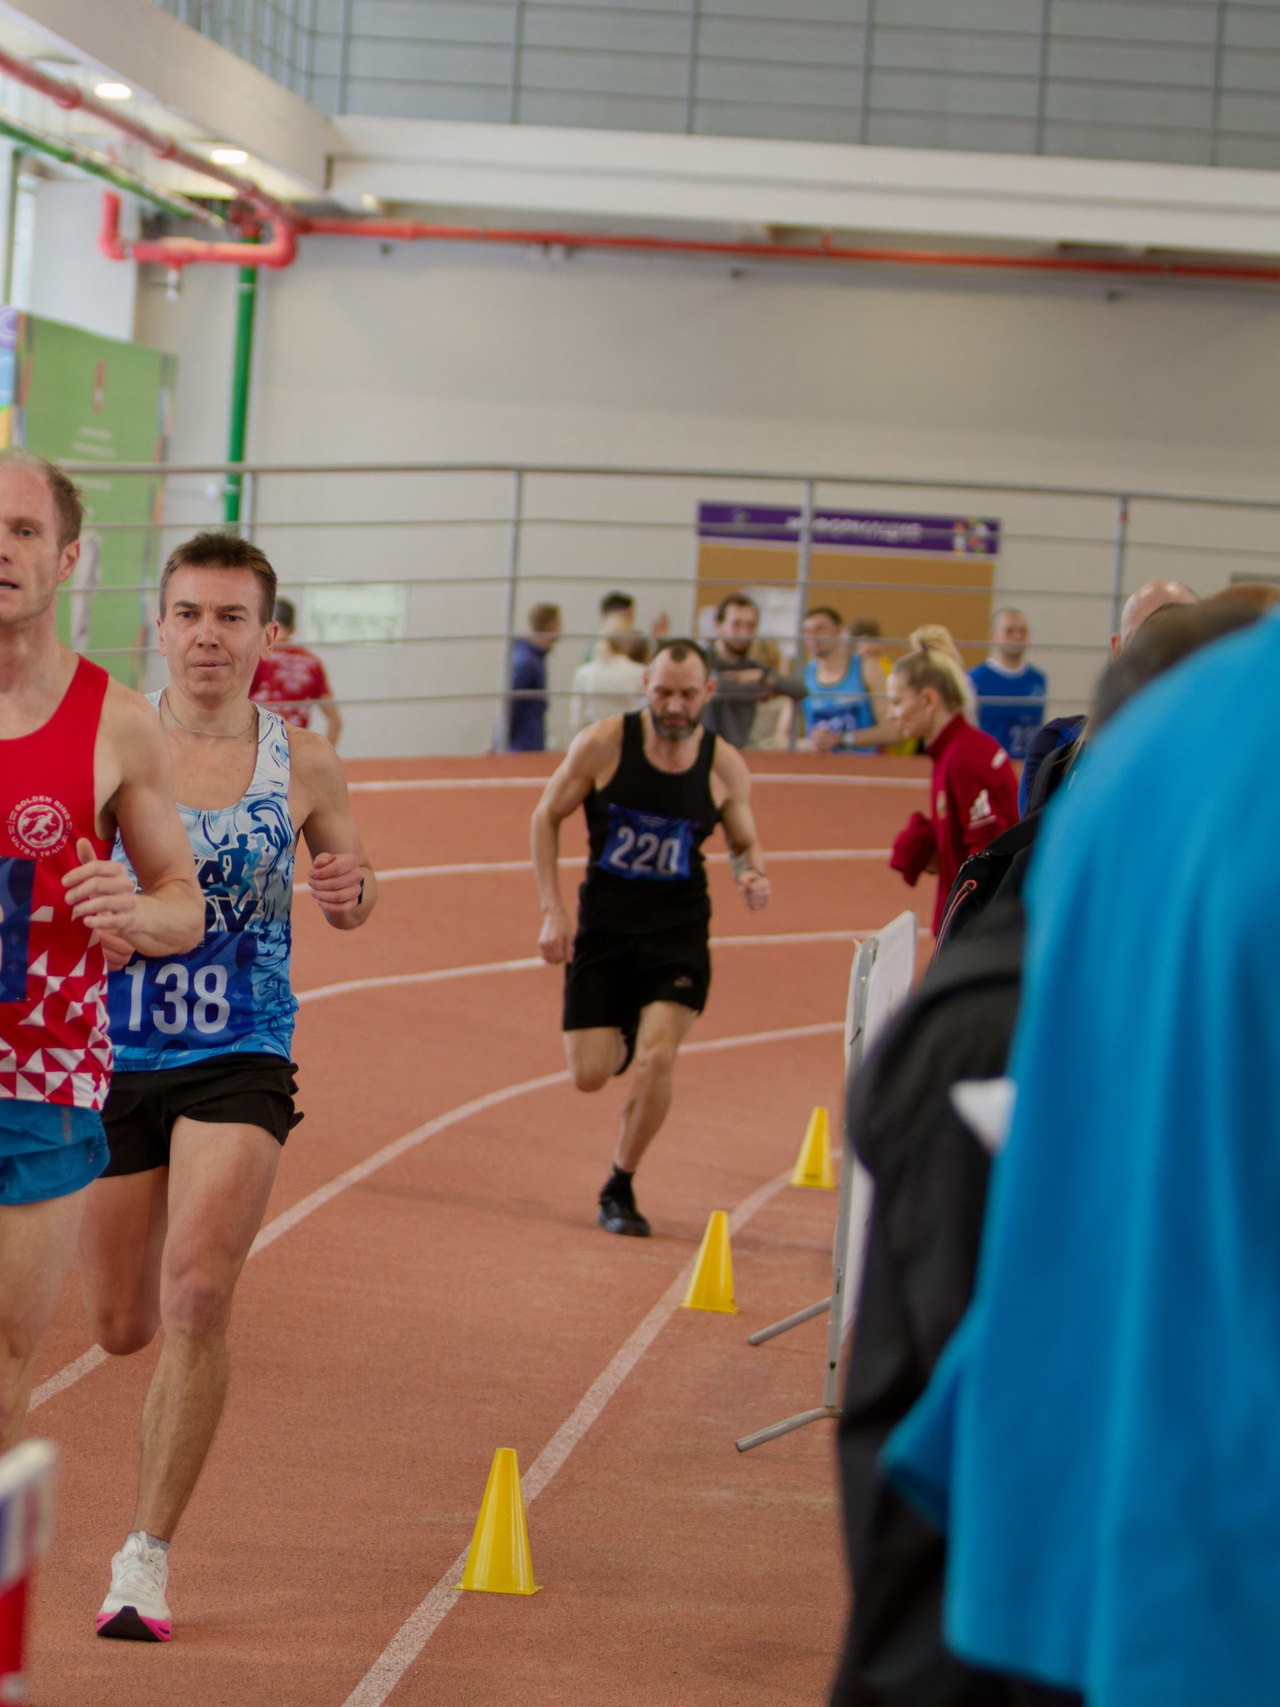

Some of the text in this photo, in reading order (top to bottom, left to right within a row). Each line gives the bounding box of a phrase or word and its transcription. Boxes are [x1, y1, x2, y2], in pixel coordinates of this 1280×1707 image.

[11, 836, 64, 857] ULTRA TRAIL
[610, 826, 681, 875] 220
[124, 959, 230, 1035] 138
